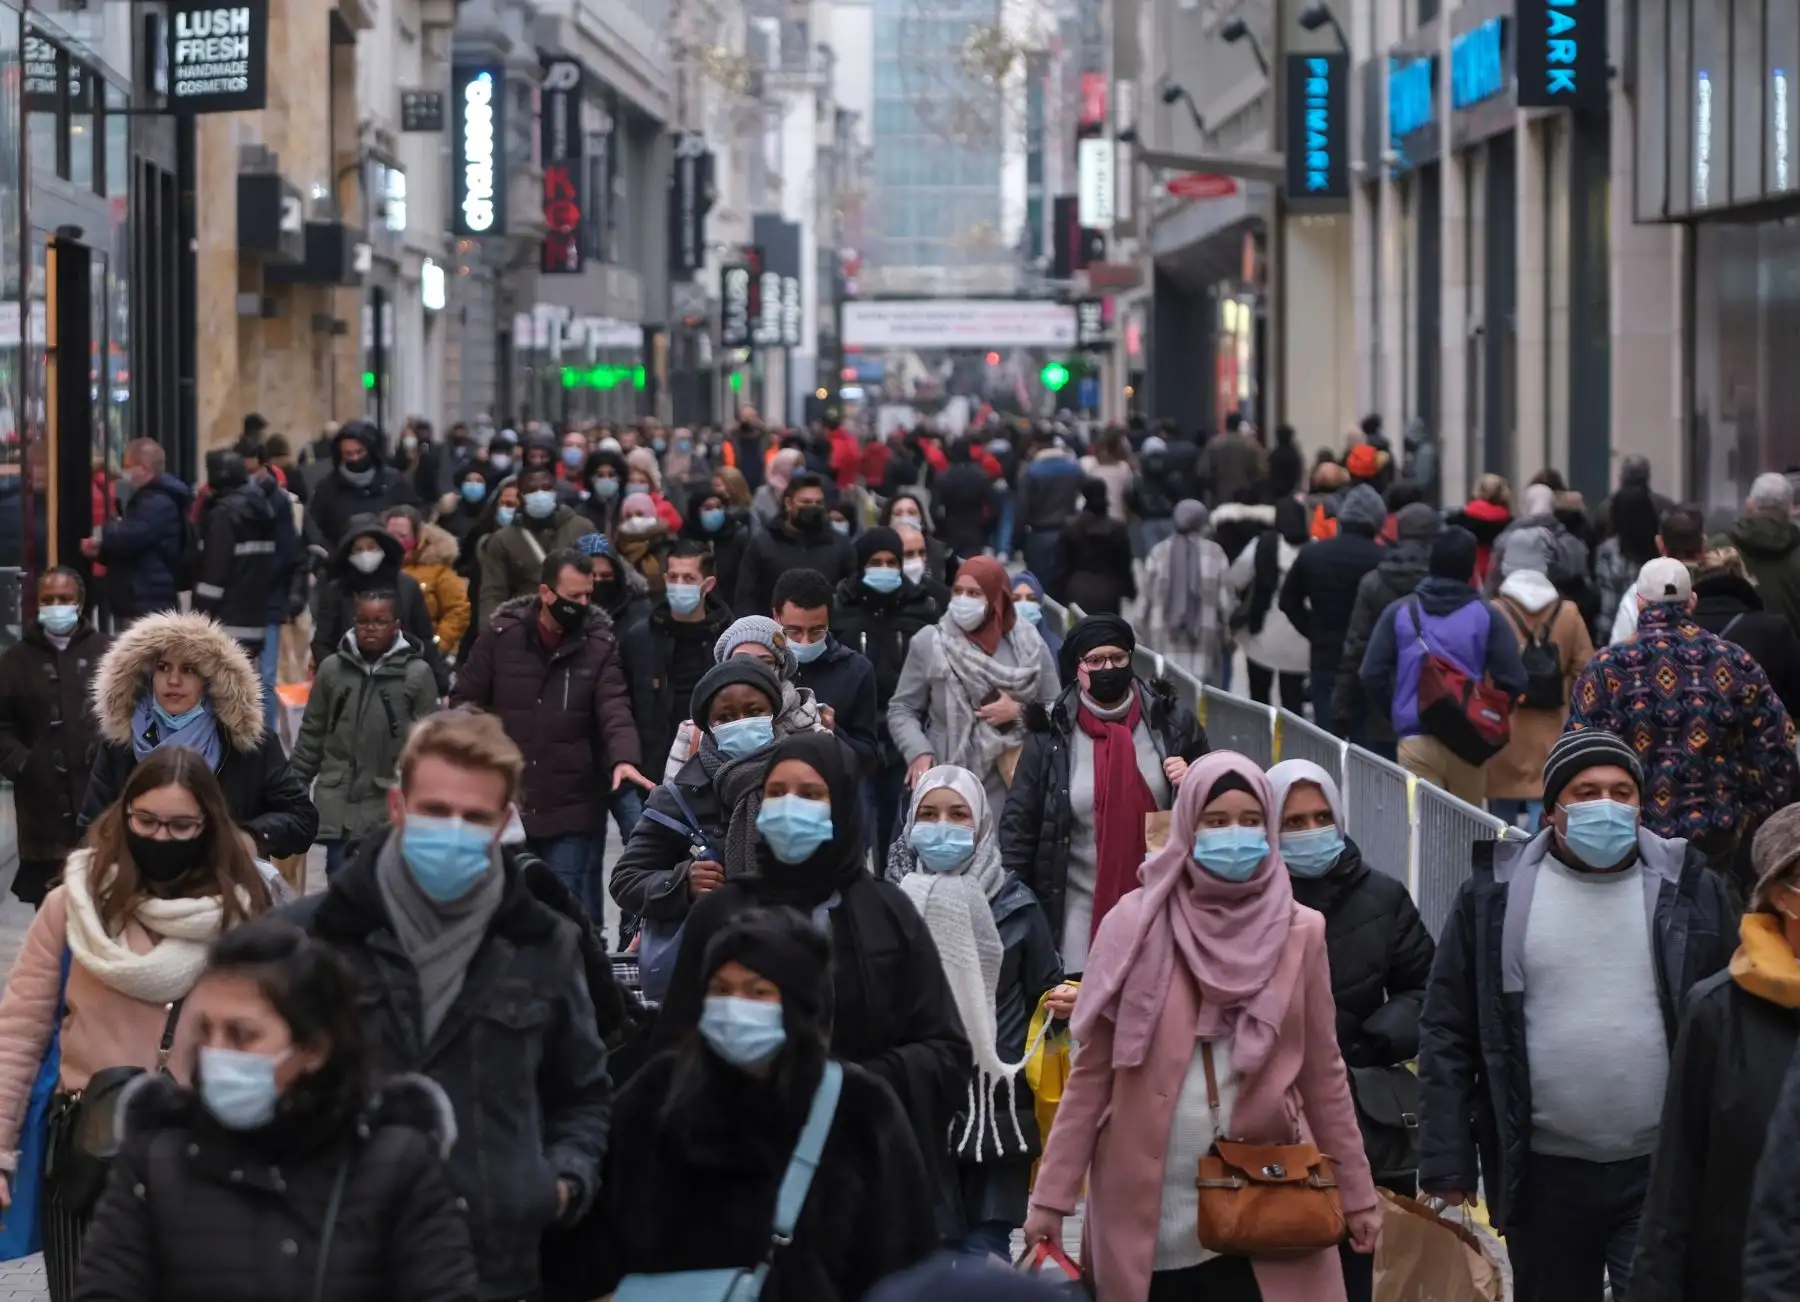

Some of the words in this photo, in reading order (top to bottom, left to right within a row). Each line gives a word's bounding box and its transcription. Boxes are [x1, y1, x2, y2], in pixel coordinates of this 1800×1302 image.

[176, 7, 250, 38] LUSH
[175, 35, 249, 63] FRESH
[1546, 0, 1577, 94] ARK
[175, 60, 249, 79] HANDMADE
[175, 77, 248, 97] COSMETICS
[1304, 58, 1329, 192] PRIMARK
